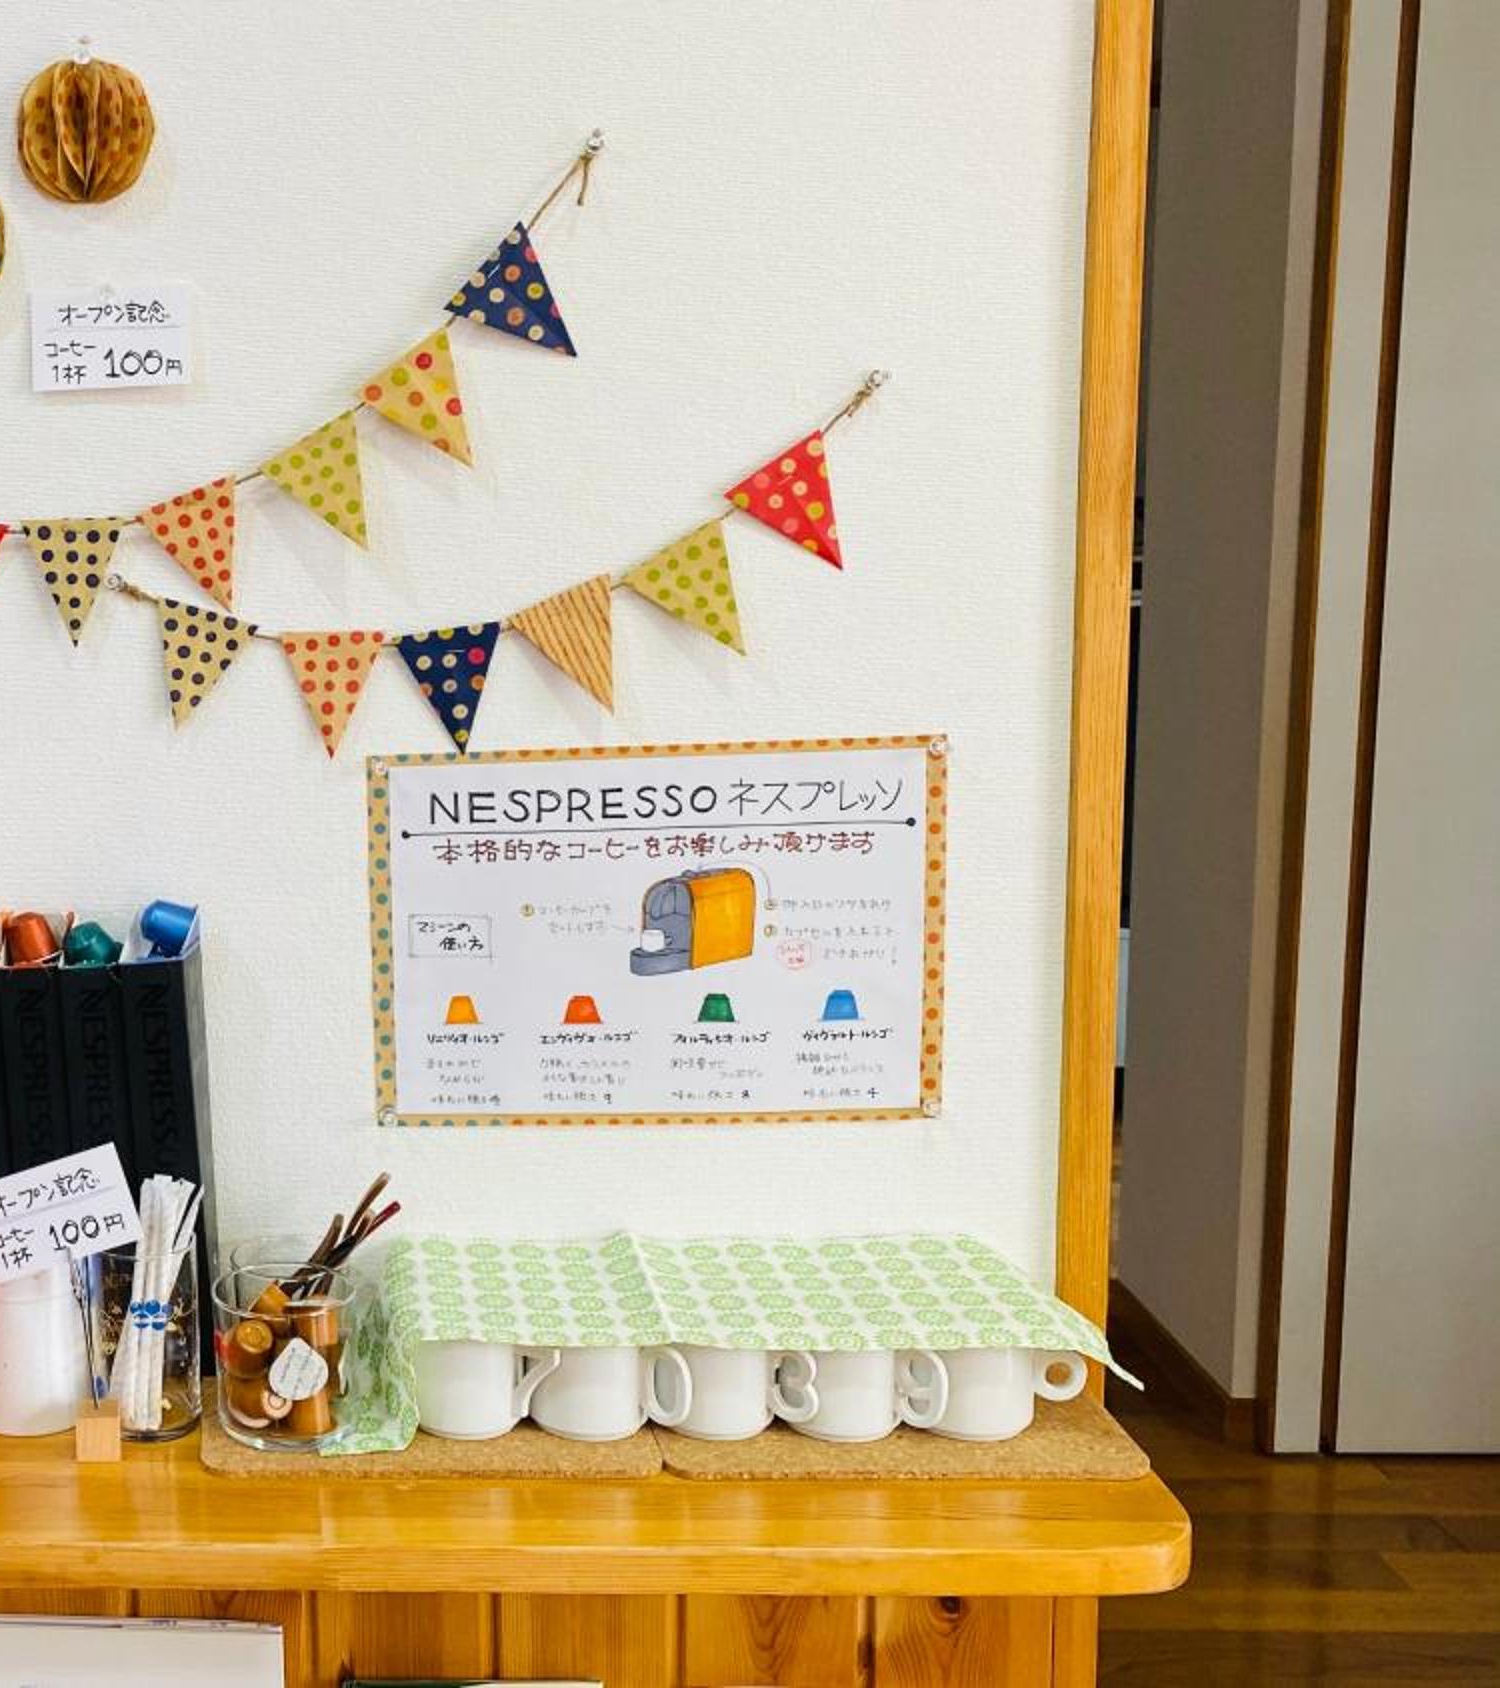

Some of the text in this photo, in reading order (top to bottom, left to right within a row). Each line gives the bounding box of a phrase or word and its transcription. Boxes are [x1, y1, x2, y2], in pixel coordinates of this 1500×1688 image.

[57, 300, 171, 326] オープン記念
[43, 340, 96, 357] コーヒー
[103, 347, 183, 379] 100円
[429, 778, 903, 825] NESPRESSO ネスプレッソ
[432, 830, 875, 866] 本格的なコーヒーをお楽しみ頂けます
[439, 936, 485, 951] 使い方
[73, 985, 112, 1133] NESPRES
[49, 1213, 125, 1251] 100円
